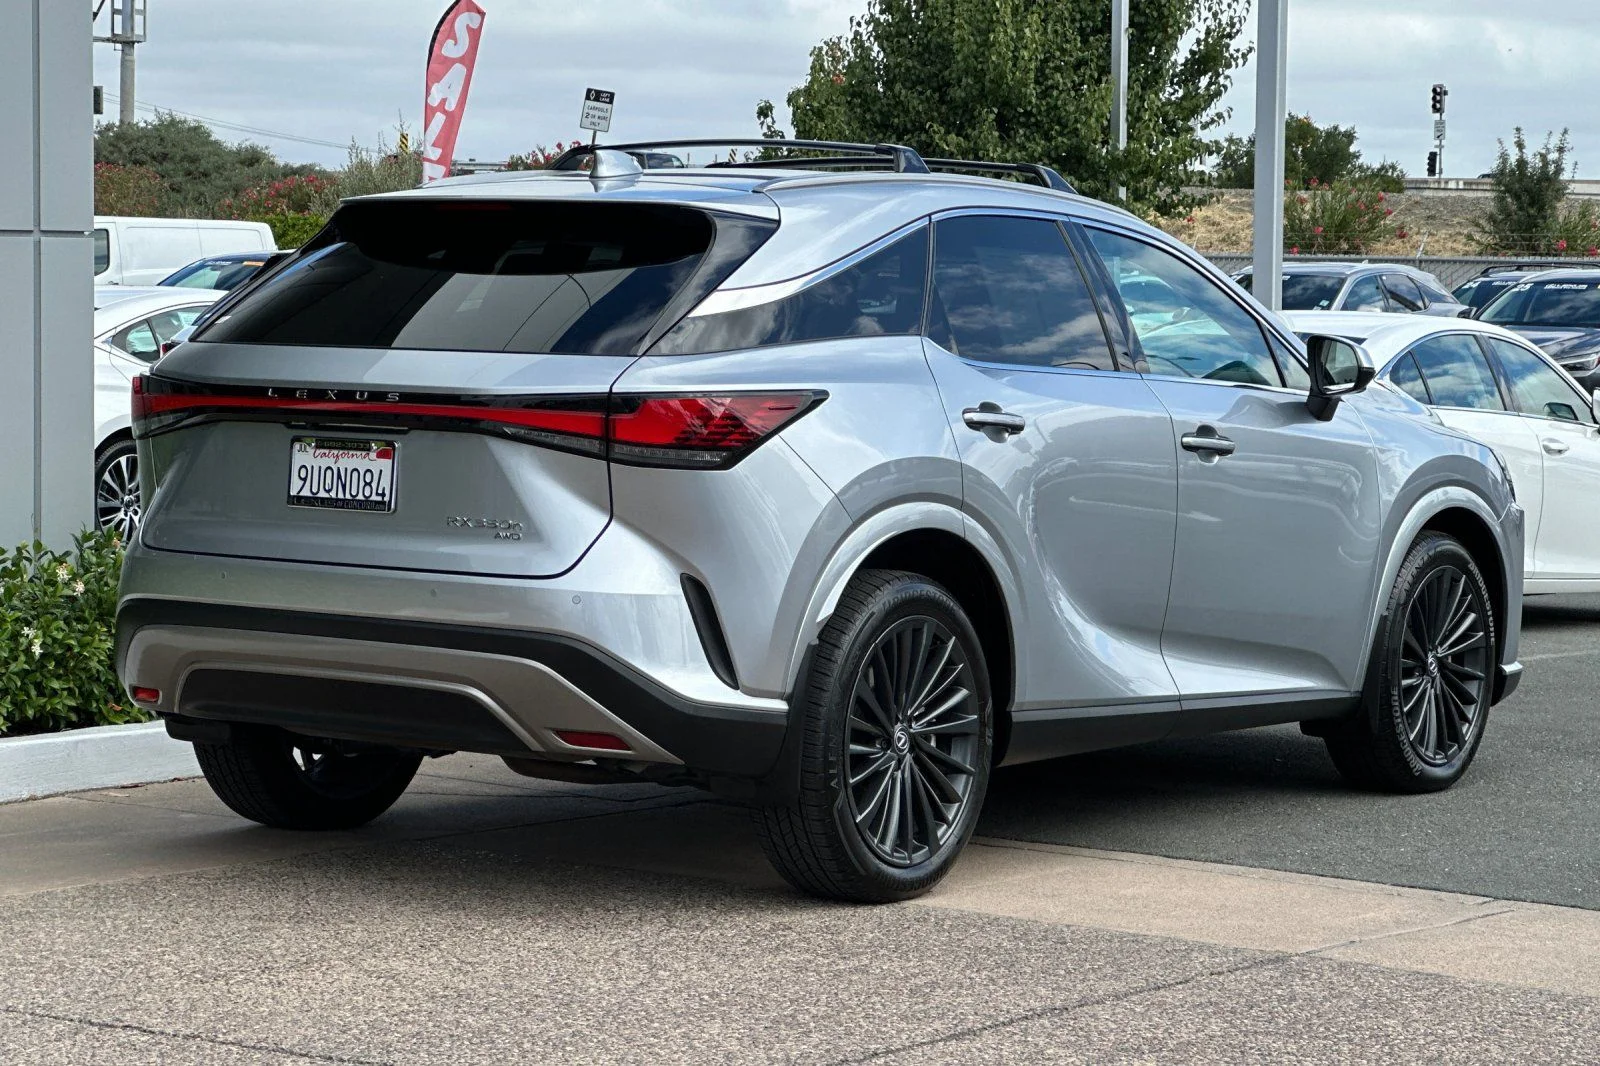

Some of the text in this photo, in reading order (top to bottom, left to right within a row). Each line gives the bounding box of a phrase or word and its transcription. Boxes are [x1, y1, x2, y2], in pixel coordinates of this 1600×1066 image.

[268, 387, 400, 402] LEXUS
[313, 447, 376, 465] California
[296, 464, 387, 502] 9UQN084
[494, 532, 523, 541] AWD
